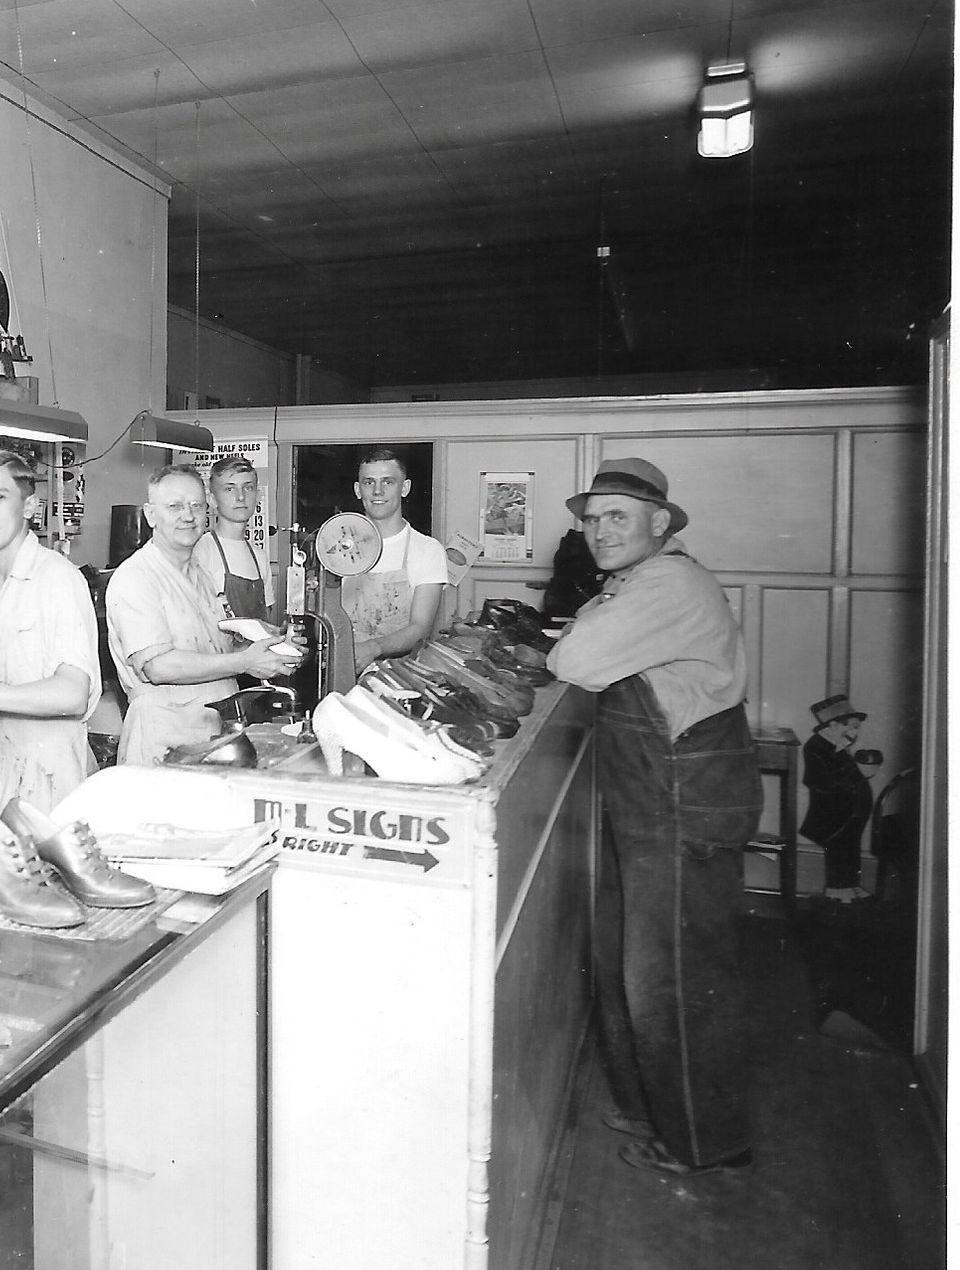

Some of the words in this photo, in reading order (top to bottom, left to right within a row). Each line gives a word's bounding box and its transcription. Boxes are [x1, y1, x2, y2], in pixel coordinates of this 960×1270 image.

[217, 444, 236, 453] HALF
[238, 443, 261, 452] SOLES
[254, 515, 264, 527] 13
[254, 529, 264, 541] 20
[327, 807, 451, 846] SIGNS
[282, 836, 355, 856] RIGHT
